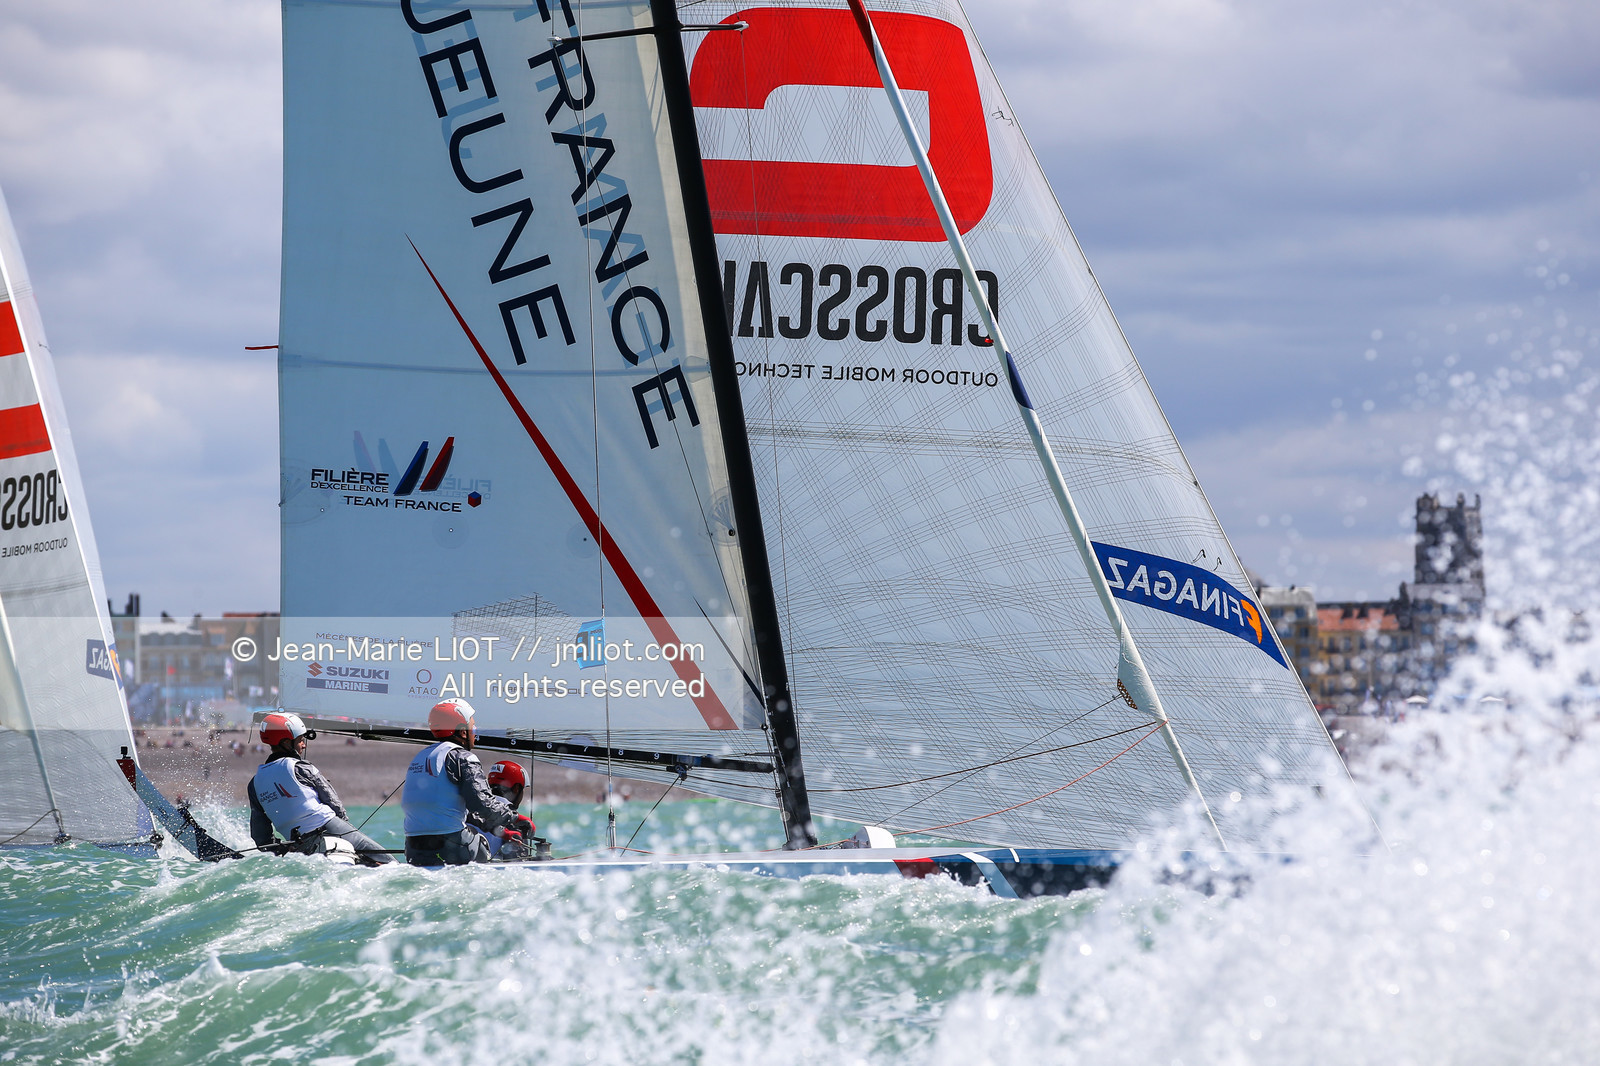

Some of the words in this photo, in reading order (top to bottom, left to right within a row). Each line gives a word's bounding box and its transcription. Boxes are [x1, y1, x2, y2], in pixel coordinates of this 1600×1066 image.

[311, 467, 389, 486] FILIÈRE
[310, 481, 389, 493] D'EXCELLENCE
[343, 495, 389, 508] TEAM
[395, 499, 462, 513] FRANCE
[326, 665, 390, 680] SUZUKI
[325, 680, 370, 692] MARINE
[408, 686, 439, 696] ATAO
[510, 737, 517, 745] 5
[546, 741, 553, 749] 6
[654, 752, 660, 760] 9
